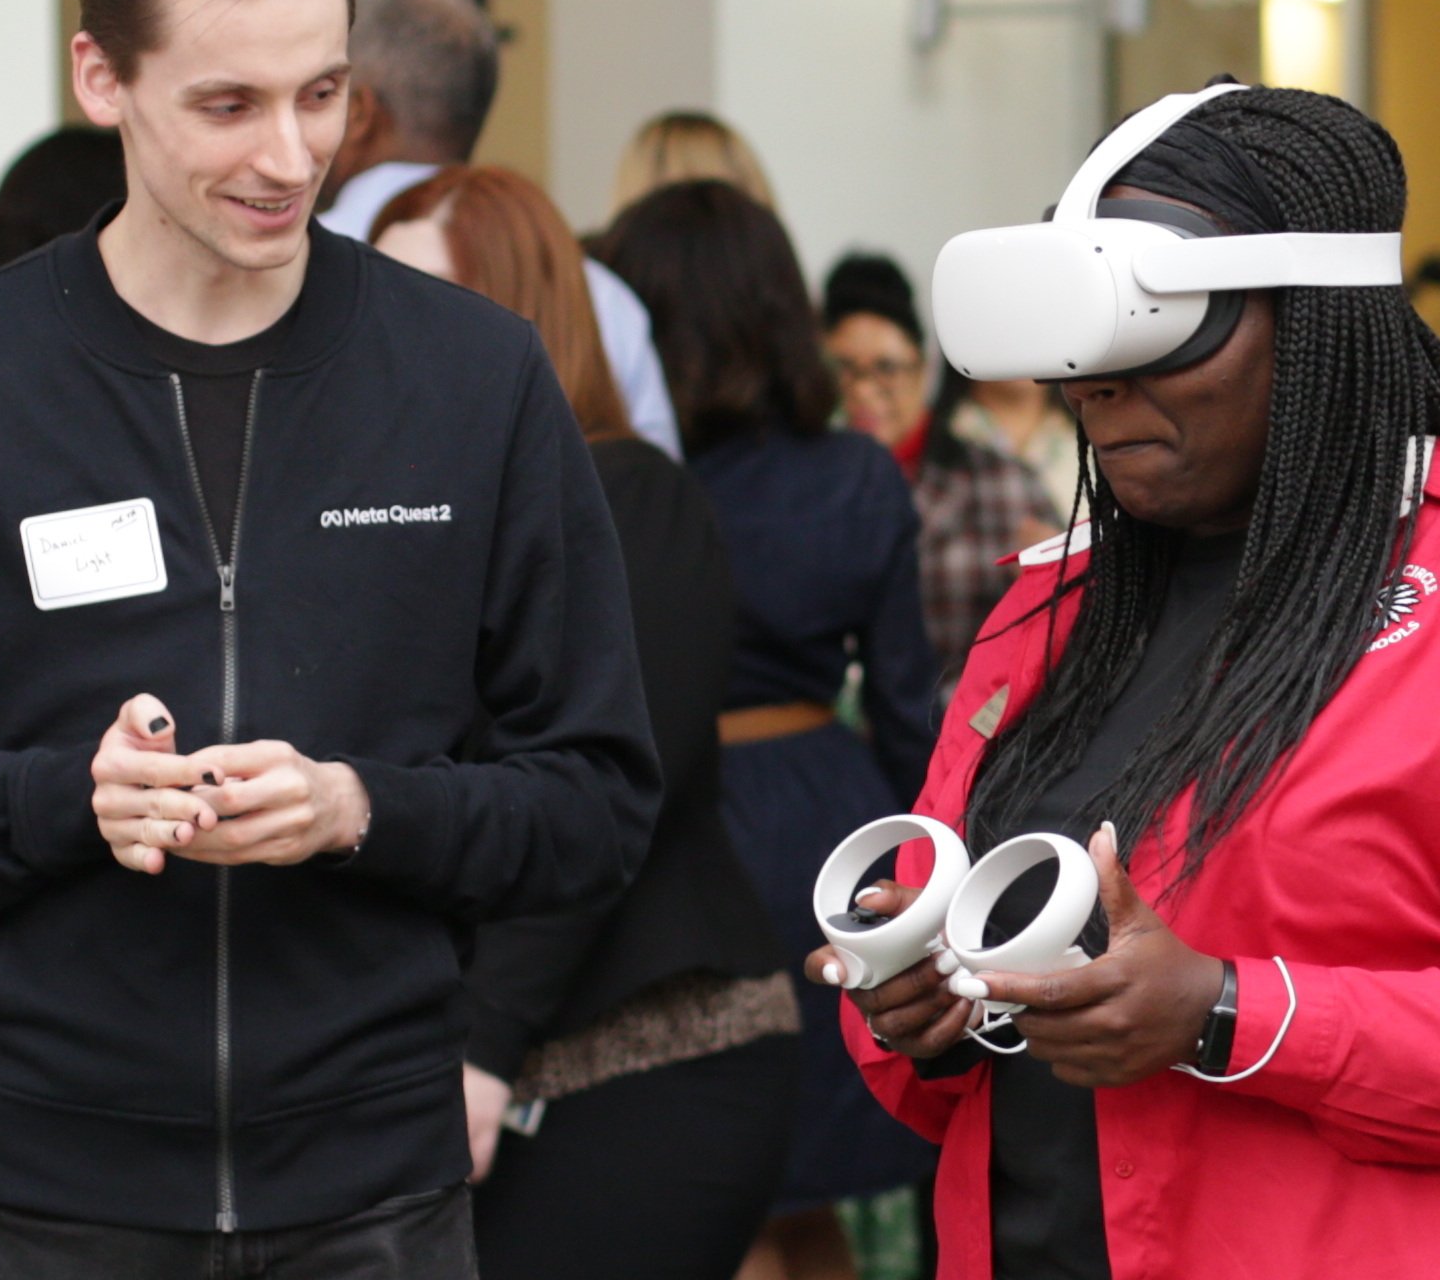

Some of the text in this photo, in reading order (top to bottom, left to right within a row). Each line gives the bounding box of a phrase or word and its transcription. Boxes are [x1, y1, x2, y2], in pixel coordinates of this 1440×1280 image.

[344, 504, 452, 527] Meta Quest 2
[1402, 564, 1438, 596] CIRCLE
